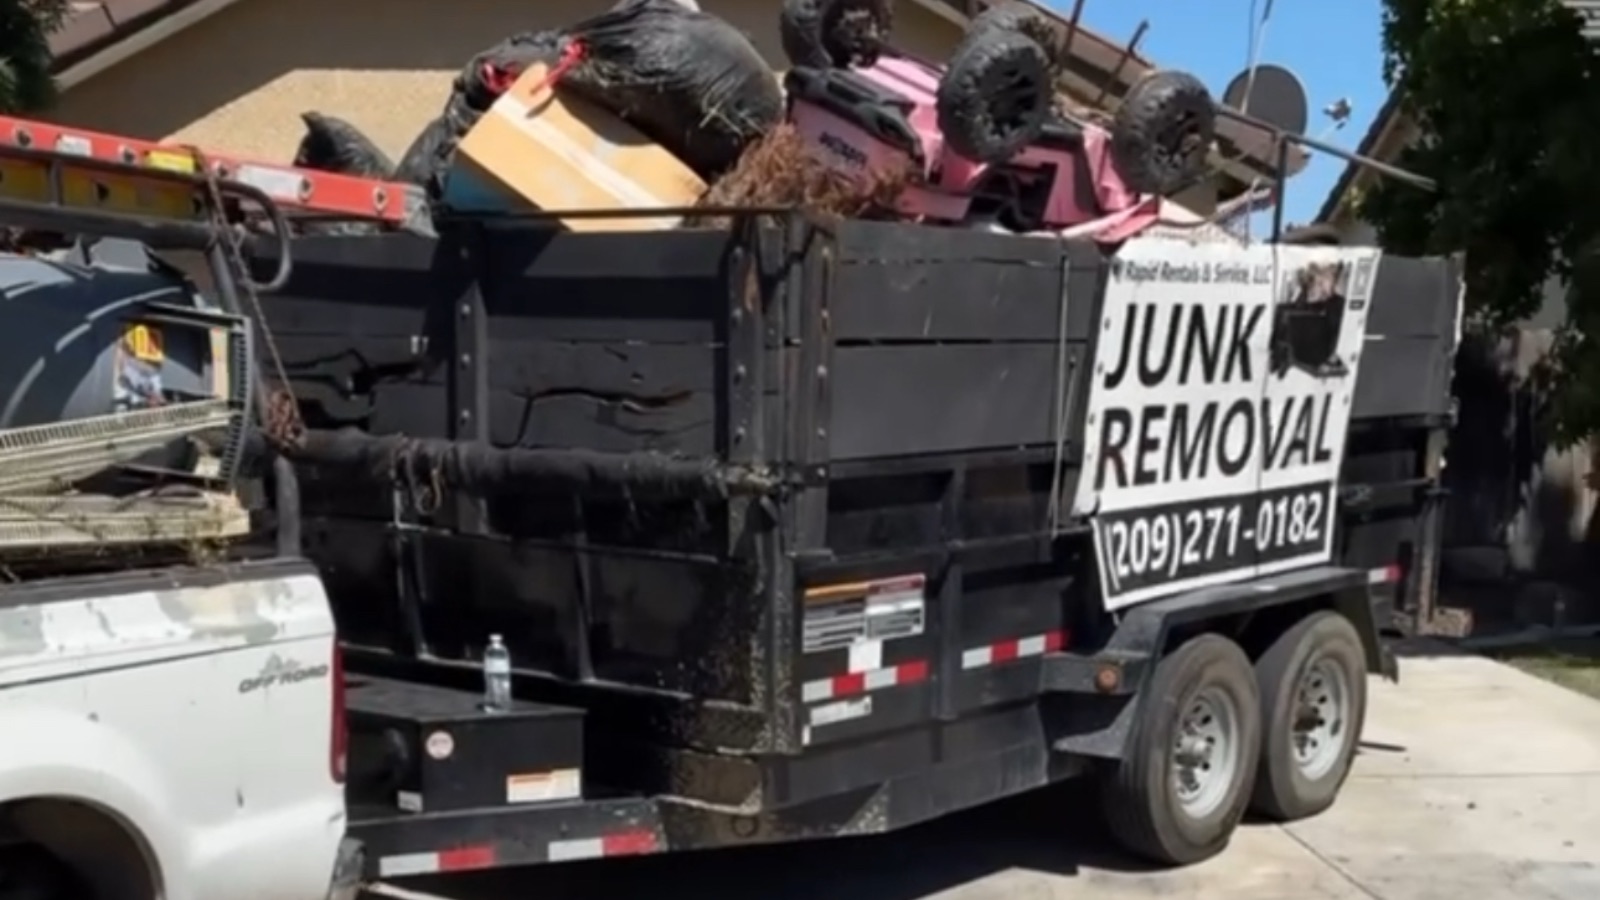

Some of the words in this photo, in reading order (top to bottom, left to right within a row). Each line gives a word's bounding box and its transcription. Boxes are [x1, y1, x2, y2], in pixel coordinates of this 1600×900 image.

[1103, 303, 1266, 390] JUNK
[1094, 392, 1332, 490] REMOVAL
[1104, 492, 1323, 591] (209)271-0182
[238, 674, 277, 693] OFF
[278, 663, 328, 685] ROAD
